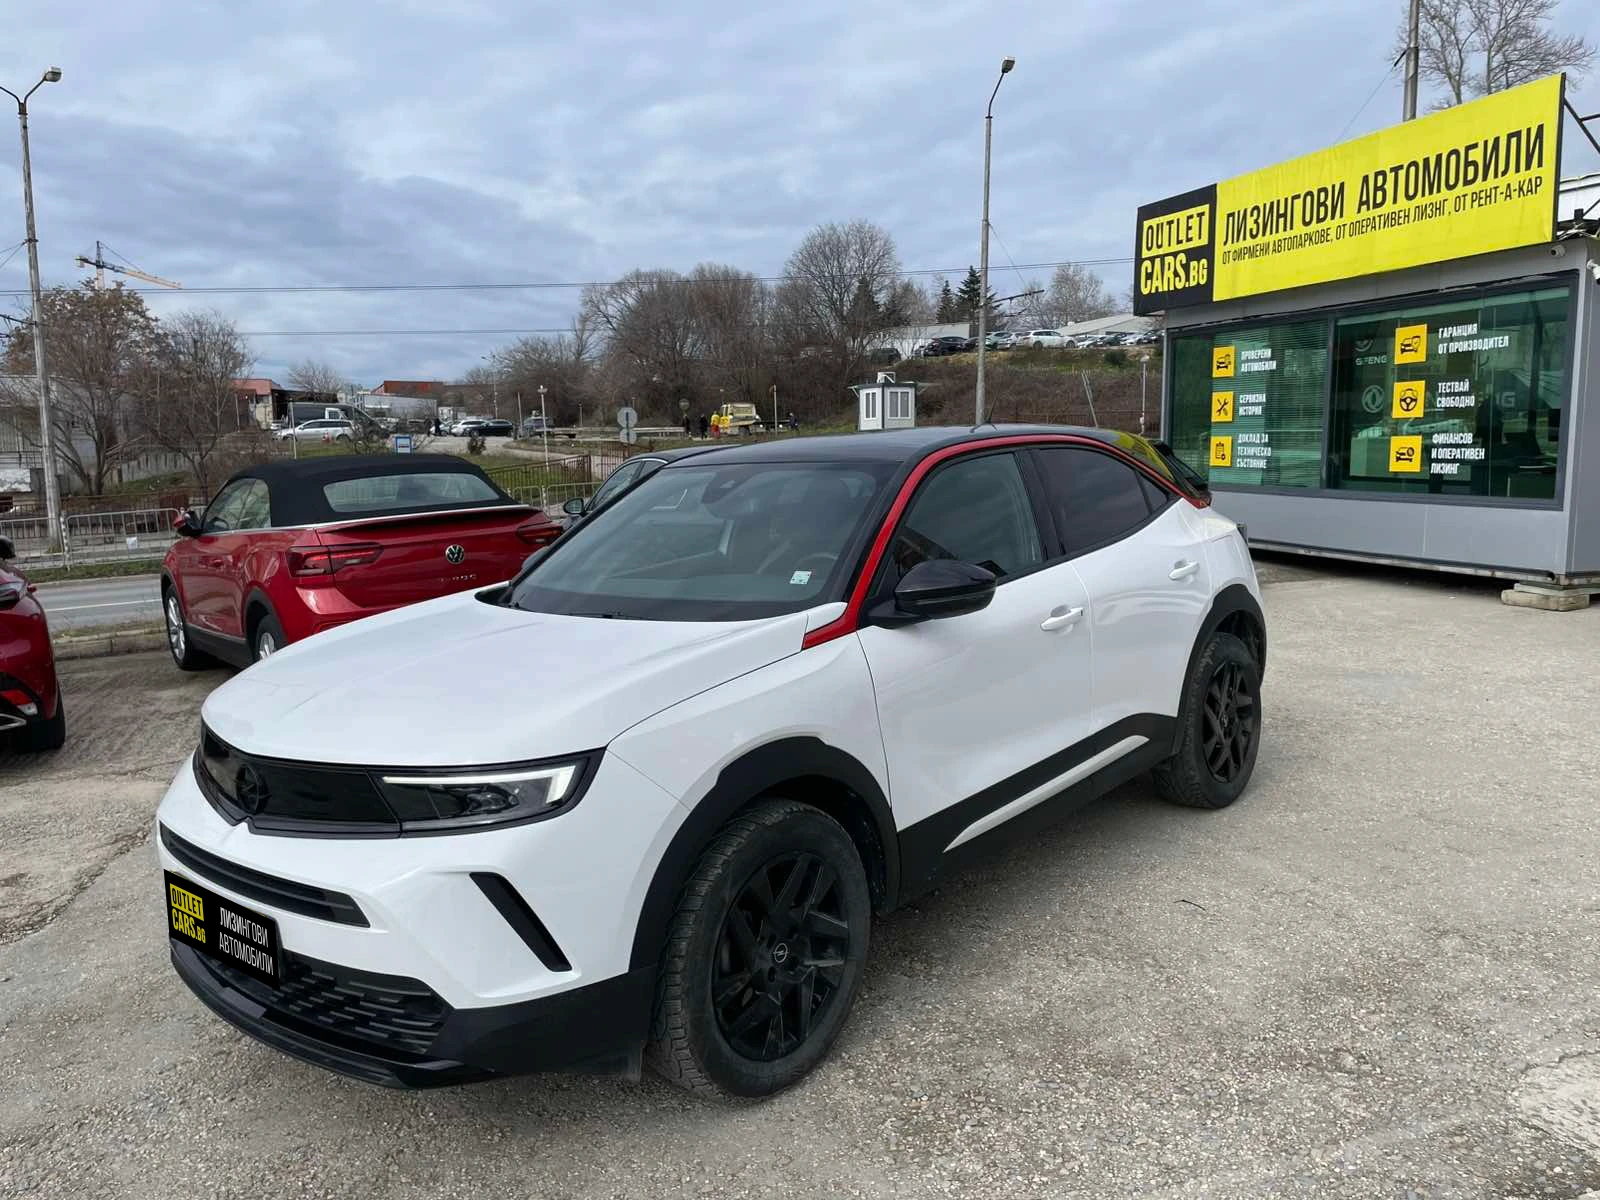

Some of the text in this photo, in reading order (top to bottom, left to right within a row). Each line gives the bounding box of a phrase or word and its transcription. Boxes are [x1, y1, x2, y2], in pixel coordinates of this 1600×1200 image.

[1223, 123, 1545, 246] ЛИЗИНГОВИ АВТОМОБИЛИ
[1146, 211, 1206, 251] OUTLET
[1222, 250, 1232, 264] ОТ
[1232, 242, 1270, 262] ФИРМЕНИ
[1271, 227, 1333, 254] АВТОПАРКОВЕ,
[1335, 223, 1348, 240] ОТ
[1349, 207, 1410, 237] ОПЕРАТИВЕН
[1454, 193, 1468, 213] ОТ
[1470, 176, 1543, 209] РЕНТ-А-КАР
[1141, 253, 1208, 295] CARS.BG
[1438, 323, 1478, 339] ГАРАНЦИЯ
[1438, 336, 1509, 354] ОТ ПРОИЗВОДИТЕЛ
[1436, 395, 1475, 408] СВОБОДНО
[1438, 378, 1470, 393] ТЕСТВАЙ
[1431, 447, 1485, 460] И ОПЕРАТИВЕН
[1432, 432, 1473, 444] ФИНАНСОВ
[1430, 462, 1460, 474] ЛИЗИНГ
[172, 887, 203, 919] OUTLET
[171, 908, 206, 944] CARS.BG
[220, 906, 269, 948] ЛИЗИНГОВИ
[219, 931, 274, 976] АВТОМОБИЛИ
